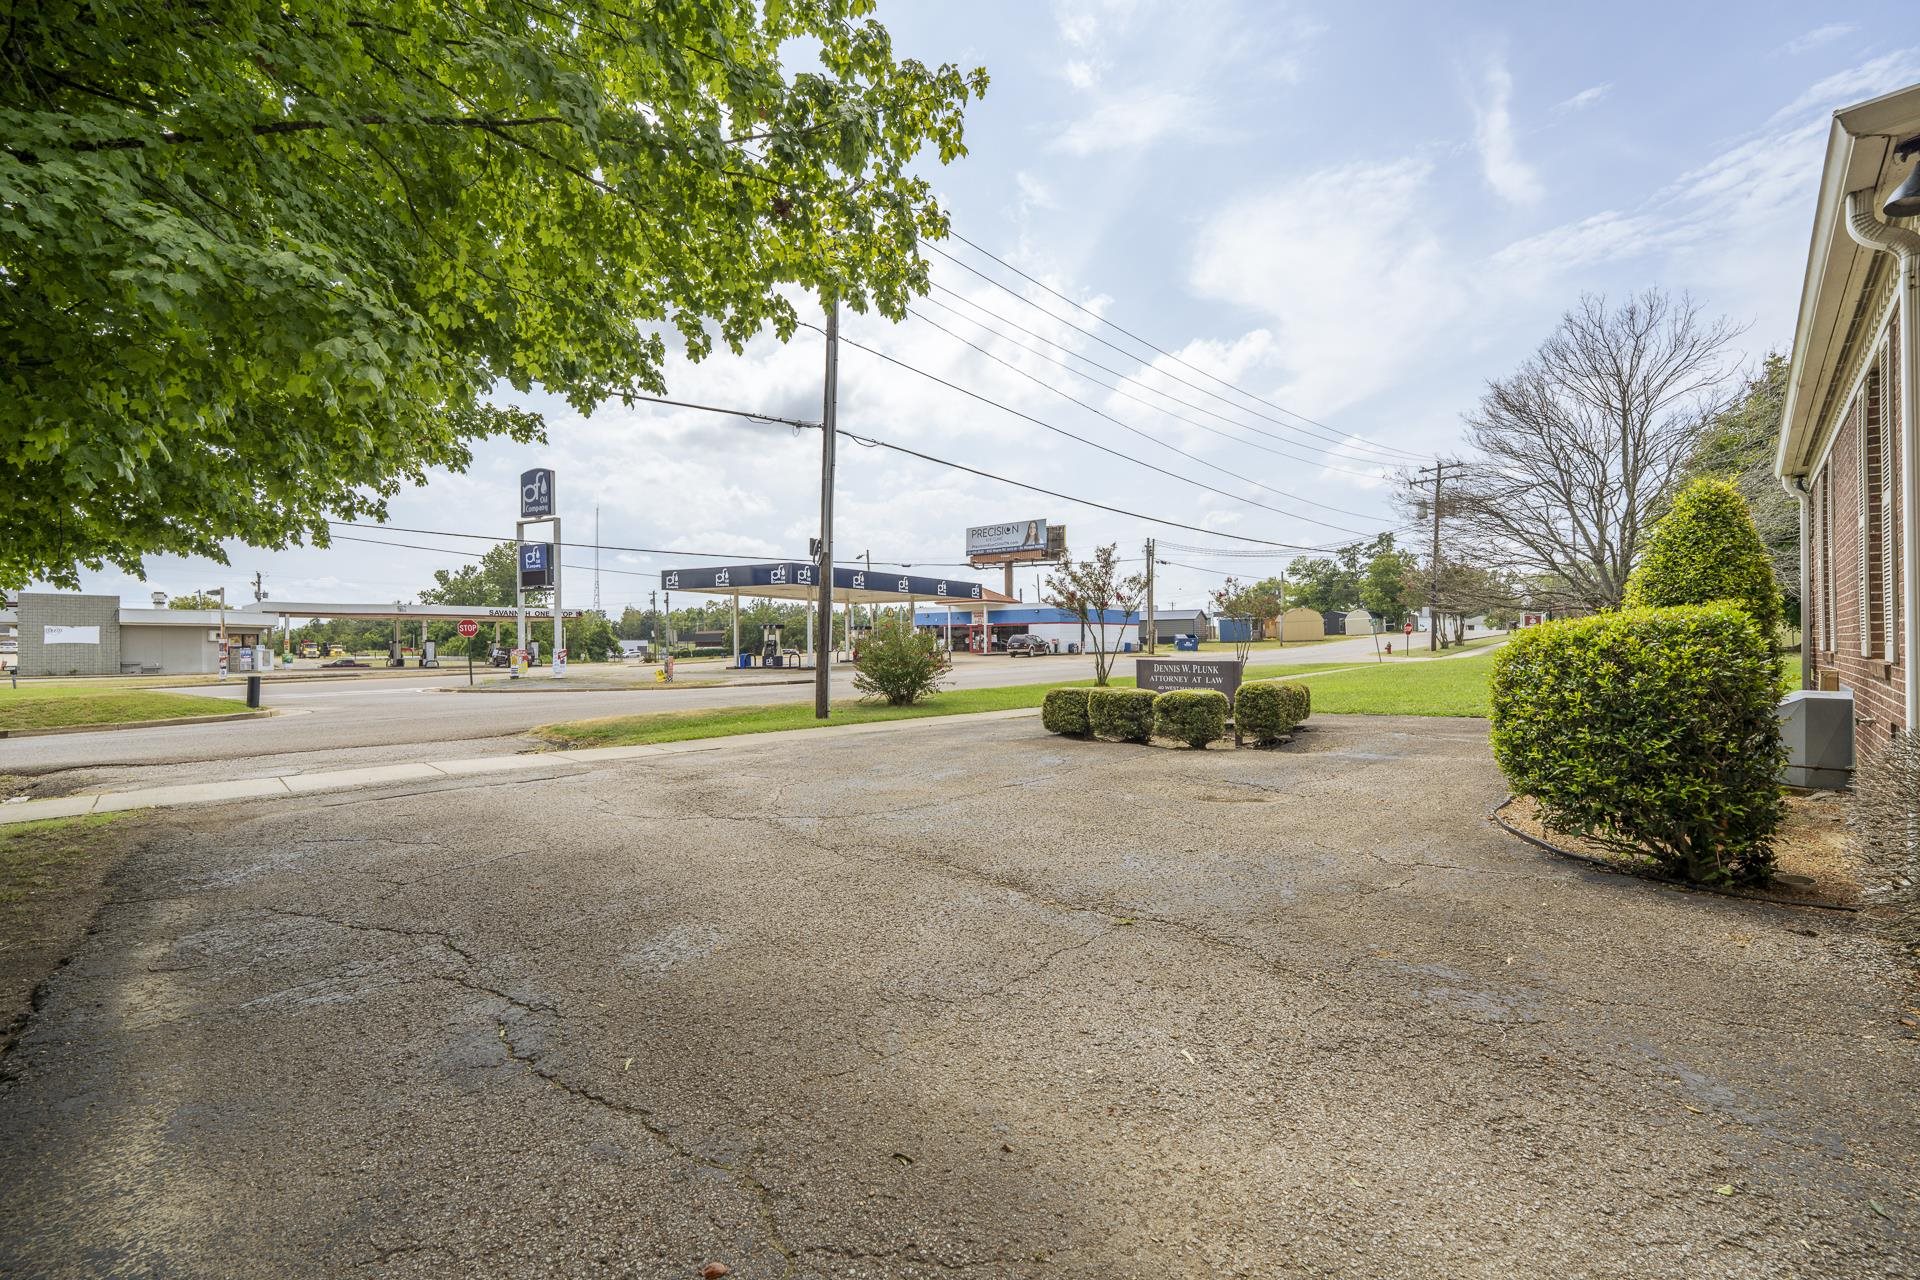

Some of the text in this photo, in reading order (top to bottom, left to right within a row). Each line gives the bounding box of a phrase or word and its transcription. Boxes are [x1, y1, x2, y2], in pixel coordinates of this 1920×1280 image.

[526, 504, 549, 513] Company
[971, 525, 1019, 539] PRECISION
[489, 609, 531, 617] SAVANNH
[459, 624, 477, 632] STOP
[1153, 663, 1219, 674] DENNIS W. PLUNK
[1149, 675, 1189, 683] ATTORNEY
[1205, 676, 1224, 684] LAW
